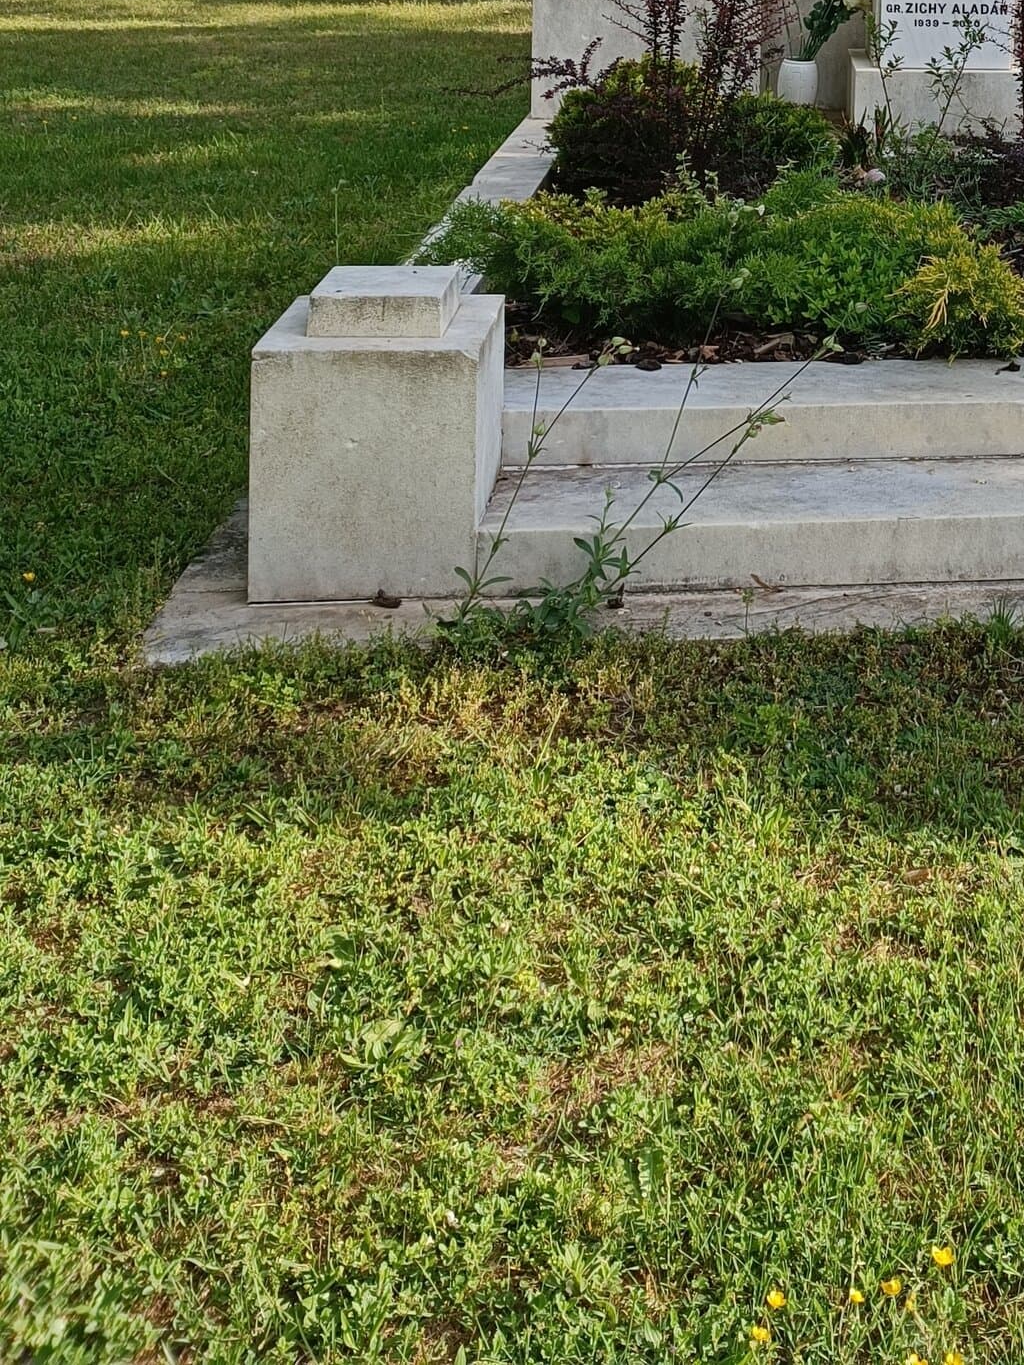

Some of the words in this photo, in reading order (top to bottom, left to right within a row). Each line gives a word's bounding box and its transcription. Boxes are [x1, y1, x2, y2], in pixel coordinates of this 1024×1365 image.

[905, 2, 947, 14] ZICHY
[951, 0, 1008, 15] ALADÁR
[914, 18, 940, 28] 1939
